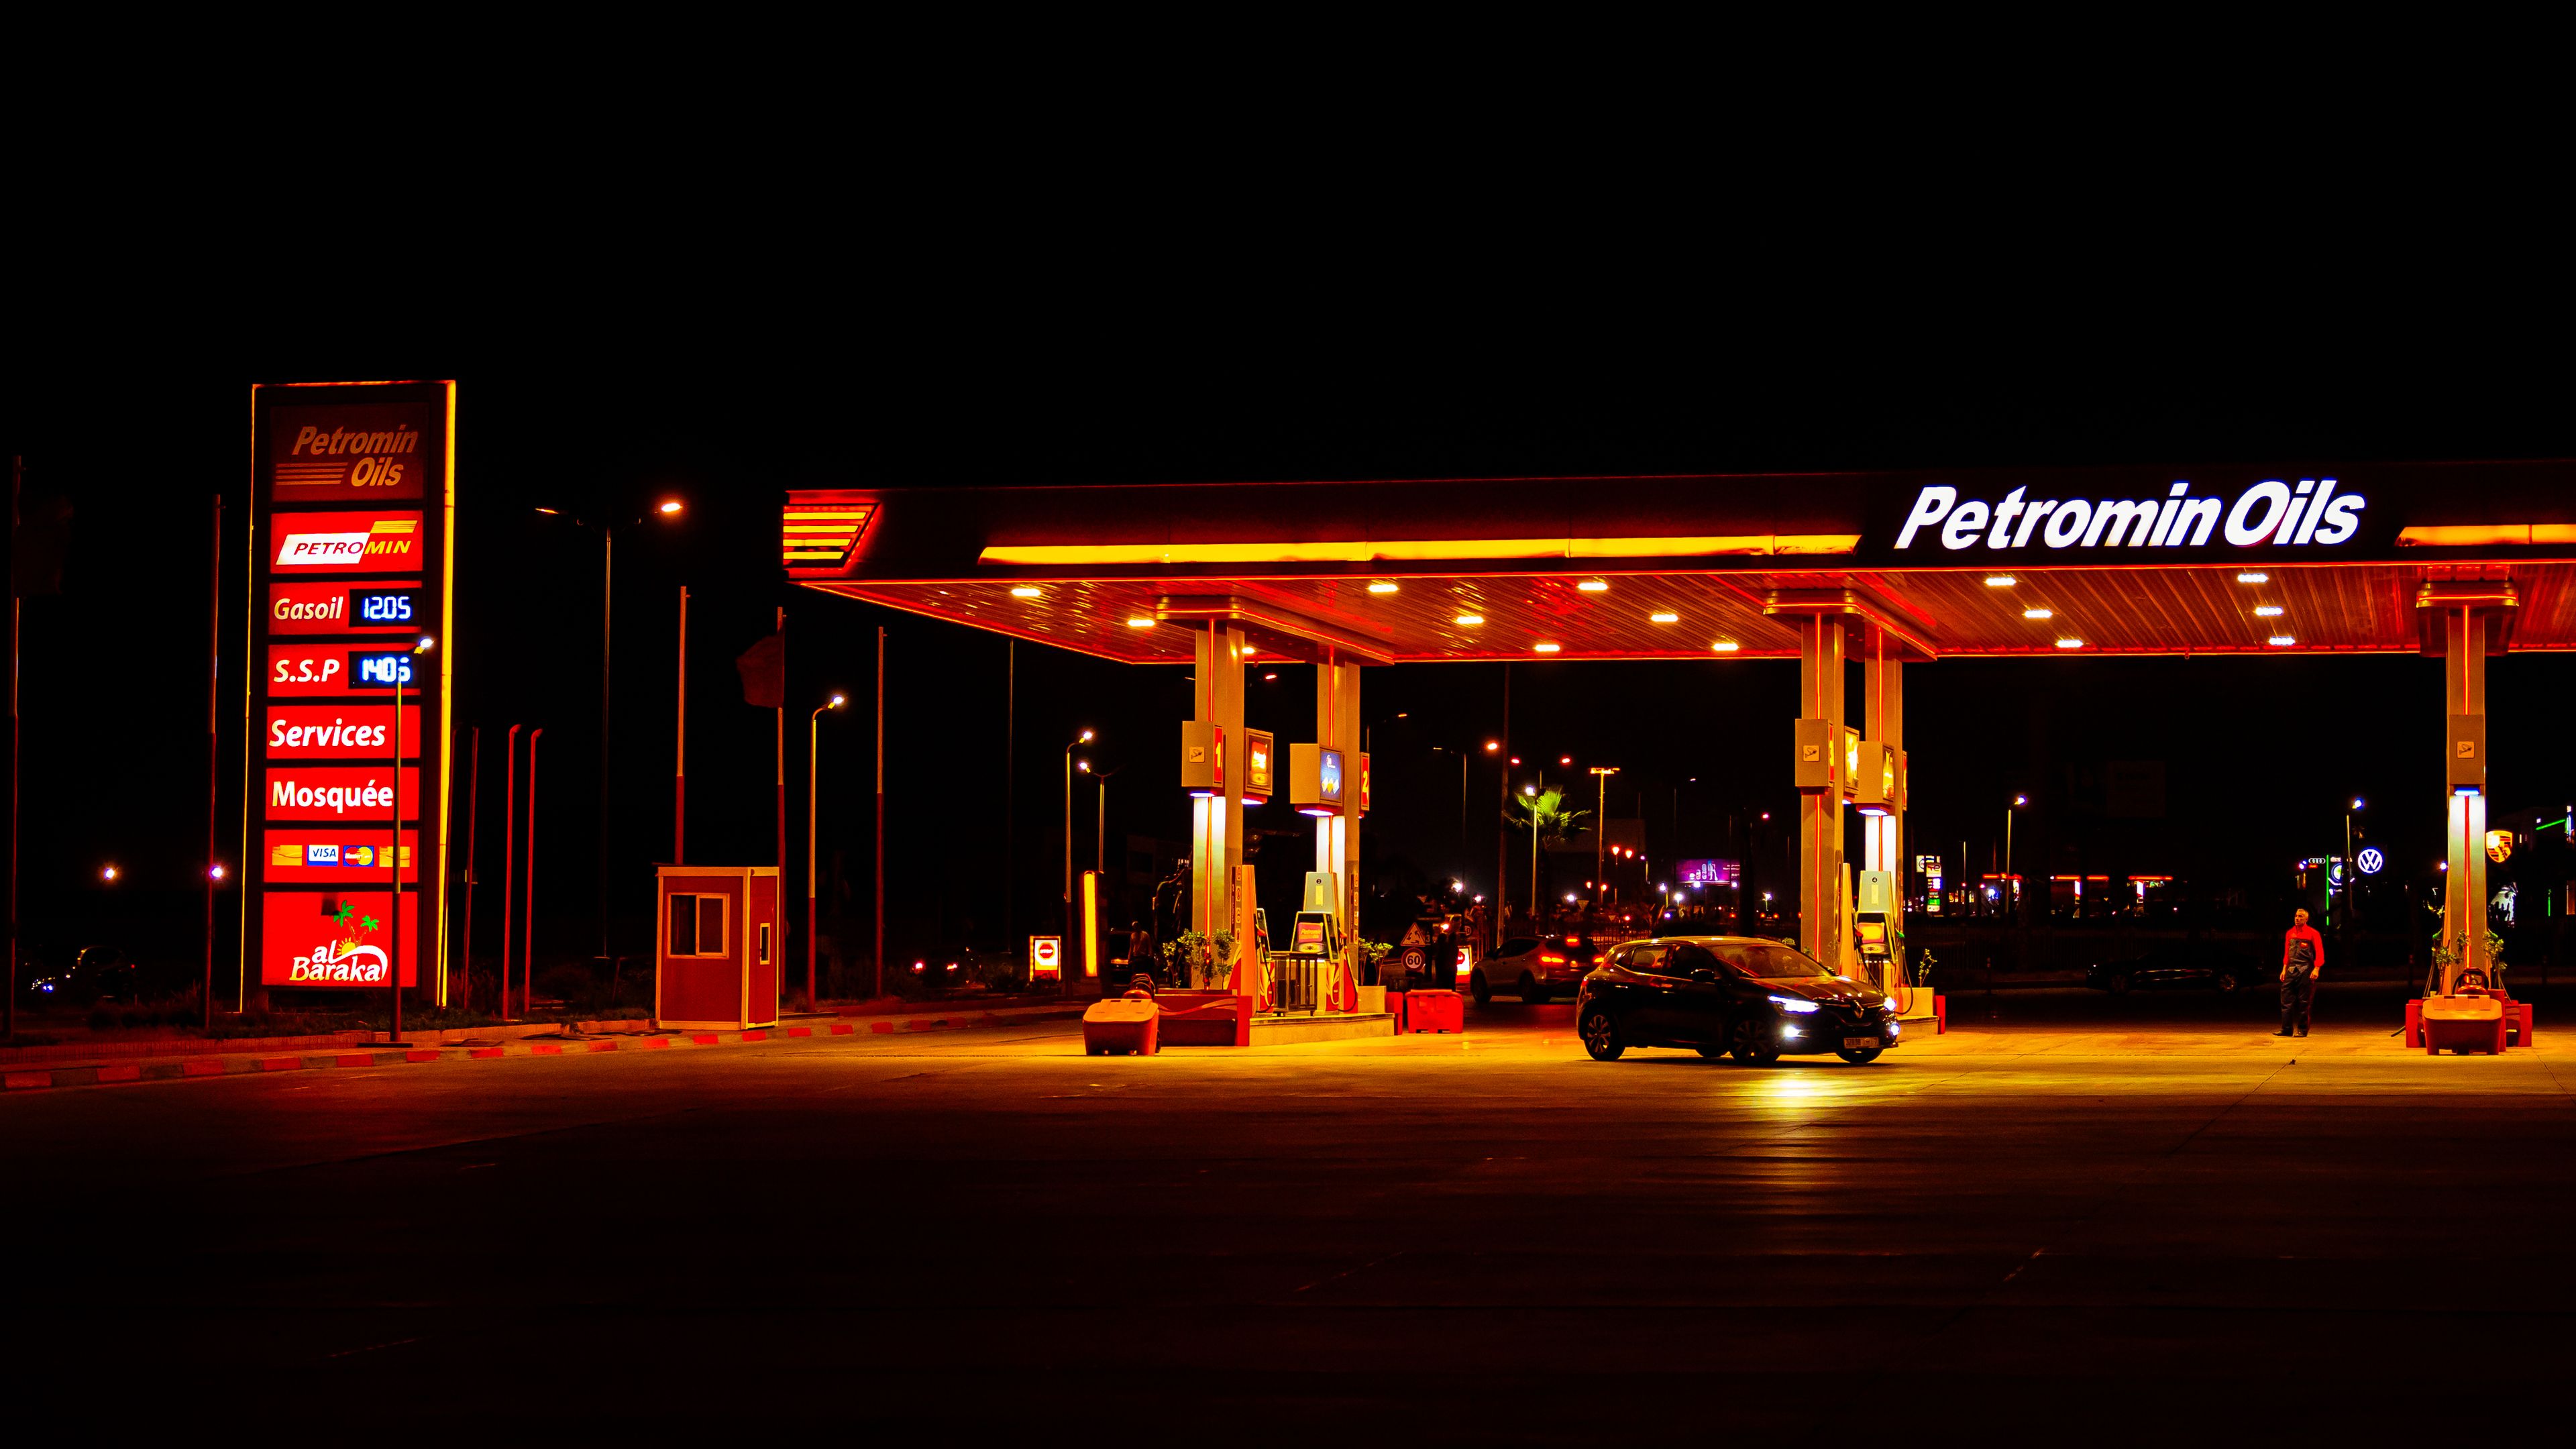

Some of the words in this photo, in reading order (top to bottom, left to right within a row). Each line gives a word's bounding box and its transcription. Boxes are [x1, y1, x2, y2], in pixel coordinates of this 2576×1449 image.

[292, 425, 419, 455] Petromin
[351, 457, 404, 487] Oils
[1893, 482, 2222, 550] Petromin
[2224, 479, 2366, 547] Oils
[294, 540, 411, 555] PETROMIN
[274, 596, 344, 621] Gasoil
[273, 659, 340, 683] S.S.P
[268, 718, 386, 747] Services
[1216, 742, 1221, 767] 1
[1362, 770, 1368, 793] 2
[272, 780, 394, 814] Mosquée
[313, 848, 336, 857] VISA
[311, 940, 341, 964] al
[1407, 955, 1421, 965] 60
[288, 956, 381, 982] Baraka
